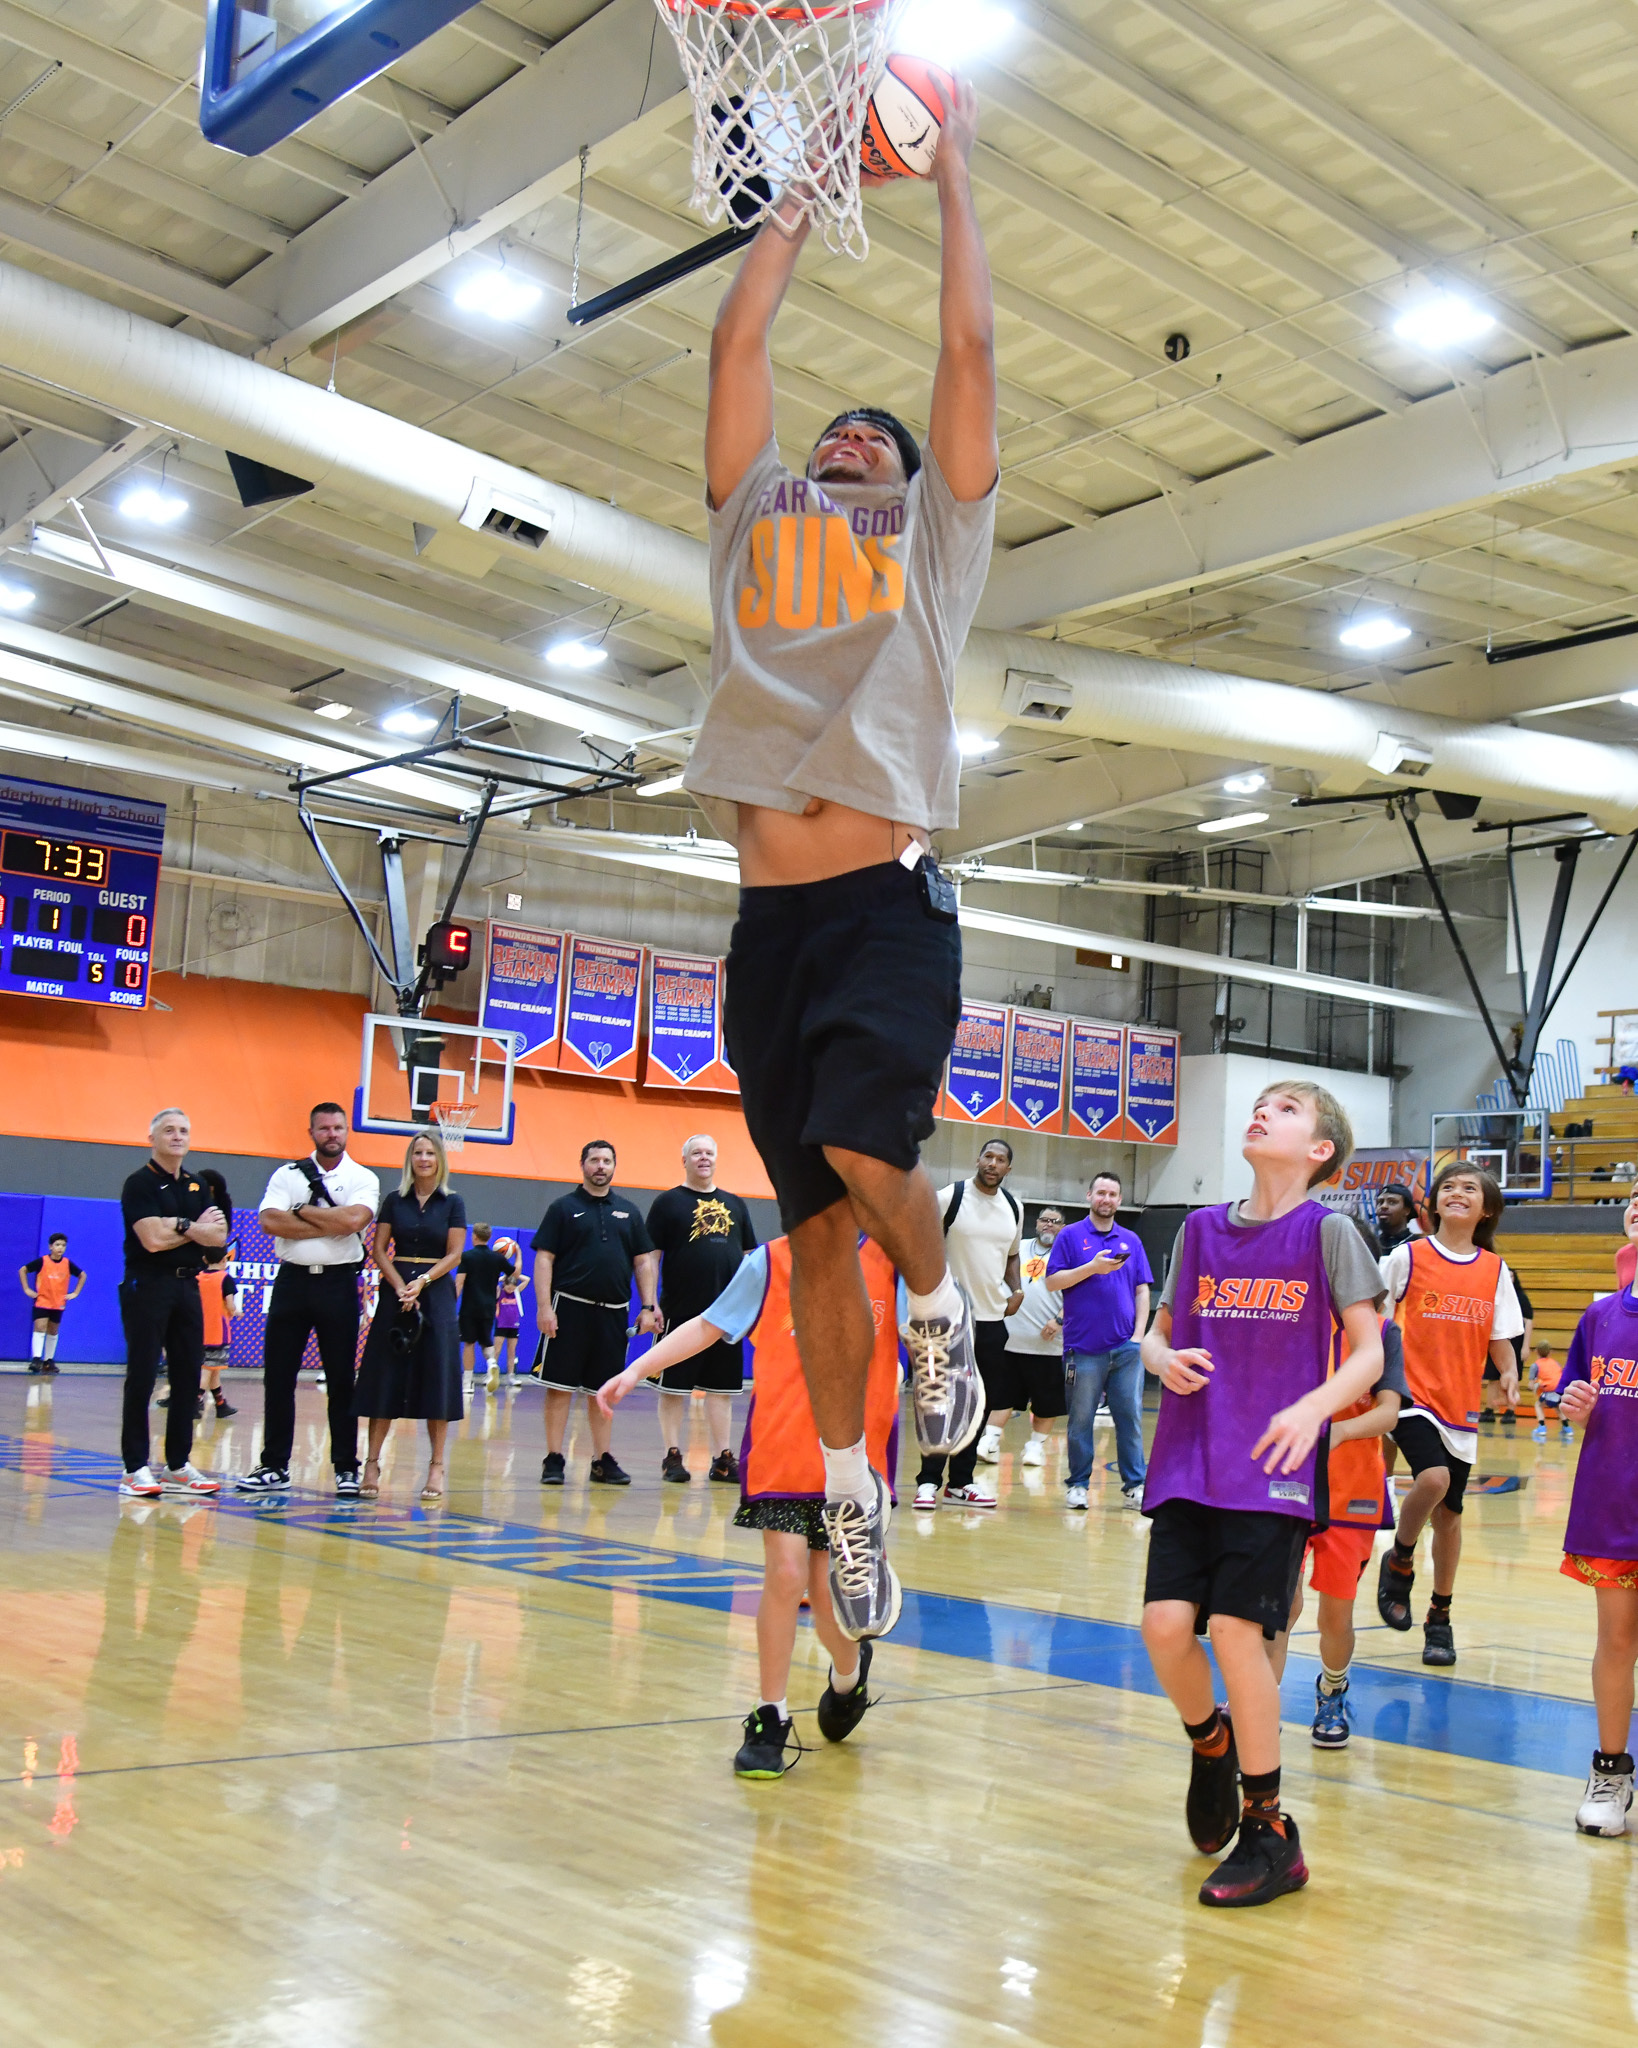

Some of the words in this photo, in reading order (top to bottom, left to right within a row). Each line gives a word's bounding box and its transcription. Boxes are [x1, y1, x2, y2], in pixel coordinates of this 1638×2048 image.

[852, 504, 904, 536] GOD
[737, 516, 906, 630] SUNS
[68, 797, 102, 816] High
[108, 804, 160, 825] School
[35, 840, 104, 881] 7:33
[34, 888, 71, 904] PERIOD
[98, 890, 147, 911] GUEST
[52, 908, 59, 930] 1
[126, 915, 146, 946] 0
[496, 928, 556, 946] THUNDERBIRD
[12, 934, 53, 950] PLAYER
[58, 940, 84, 955] FOUL
[579, 942, 636, 959] THUNDERBIRD
[116, 948, 148, 963] FOULS
[492, 944, 558, 974] REGION
[658, 958, 713, 972] THUNDERBIRD
[124, 962, 142, 988] 0
[494, 960, 554, 984] CHAMPS
[574, 958, 637, 987] REGION
[26, 980, 64, 996] MATCH
[576, 974, 634, 997] CHAMPS
[655, 974, 714, 999] REGION
[110, 991, 143, 1006] SCORE
[489, 998, 520, 1011] SECTION
[521, 1003, 552, 1015] CHAMPS
[657, 989, 712, 1009] CHAMPS
[571, 1012, 602, 1024] SECTION
[602, 1016, 632, 1028] CHAMPS
[1018, 1016, 1062, 1031] THUNDERBIRD
[655, 1026, 683, 1037] SECTION
[684, 1029, 712, 1039] CHAMPS
[956, 1020, 1004, 1044] REGION
[1077, 1027, 1119, 1039] THUNDERBIRD
[954, 1034, 1001, 1053] CHAMPS
[1015, 1030, 1062, 1055] REGION
[1075, 1040, 1120, 1060] REGION
[1016, 1044, 1060, 1063] CHAMPS
[1076, 1054, 1118, 1071] CHAMPS
[1132, 1053, 1173, 1070] STATE
[952, 1066, 976, 1077] SECTION
[976, 1070, 1000, 1080] CHAMPS
[1133, 1067, 1173, 1083] CHAMPS
[1013, 1076, 1036, 1086] SECTION
[1036, 1079, 1058, 1090] CHAMPS
[1074, 1085, 1096, 1094] SECTION
[1096, 1087, 1117, 1097] CHAMPS
[1128, 1096, 1154, 1105] NATIONAL
[1154, 1098, 1174, 1107] CHAMPS
[1343, 1161, 1416, 1190] SUNS
[1214, 1278, 1309, 1312] SUNS
[1441, 1294, 1493, 1319] SUNS
